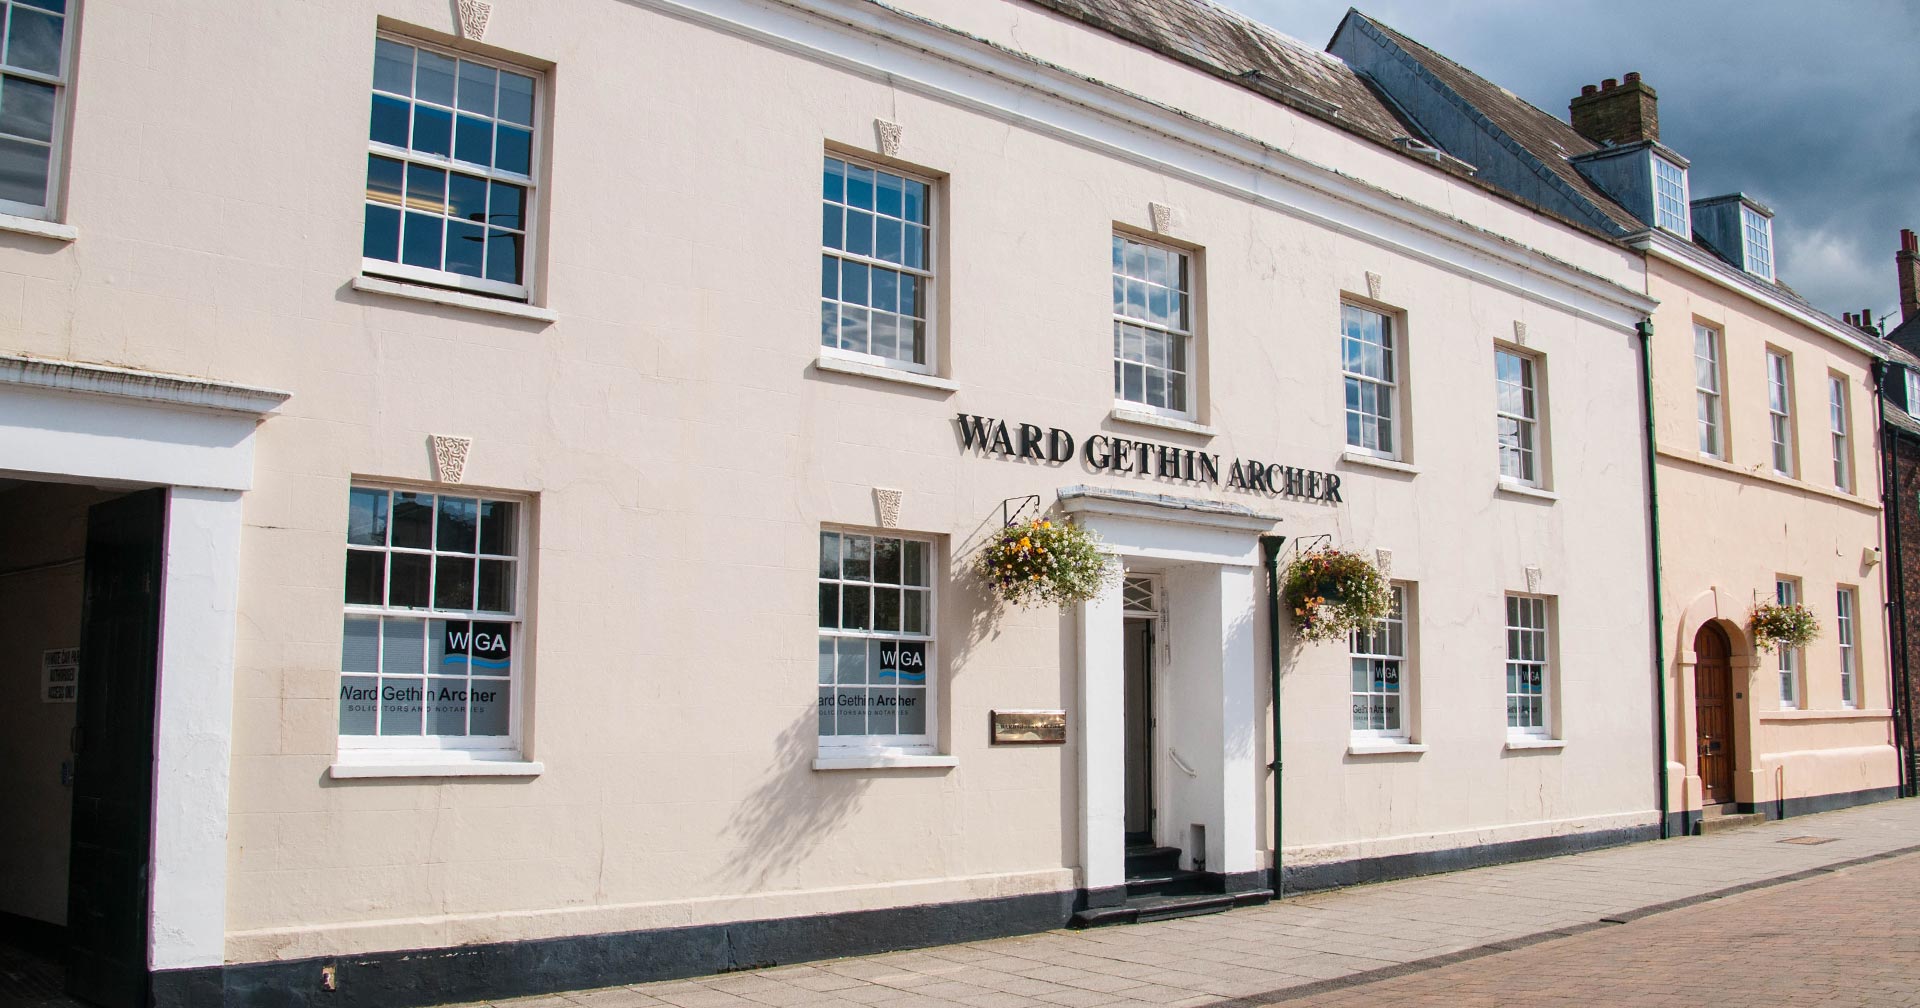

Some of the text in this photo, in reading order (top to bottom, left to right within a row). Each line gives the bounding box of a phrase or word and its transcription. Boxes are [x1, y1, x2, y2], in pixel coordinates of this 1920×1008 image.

[957, 413, 1343, 503] WARD GETHIN ARCHER
[449, 631, 507, 652] WGA
[882, 650, 922, 666] WGA
[383, 685, 435, 701] Gethin
[439, 687, 497, 703] Archer
[818, 694, 917, 706] ard Gethin Archer
[348, 704, 409, 713] SOLICTORS
